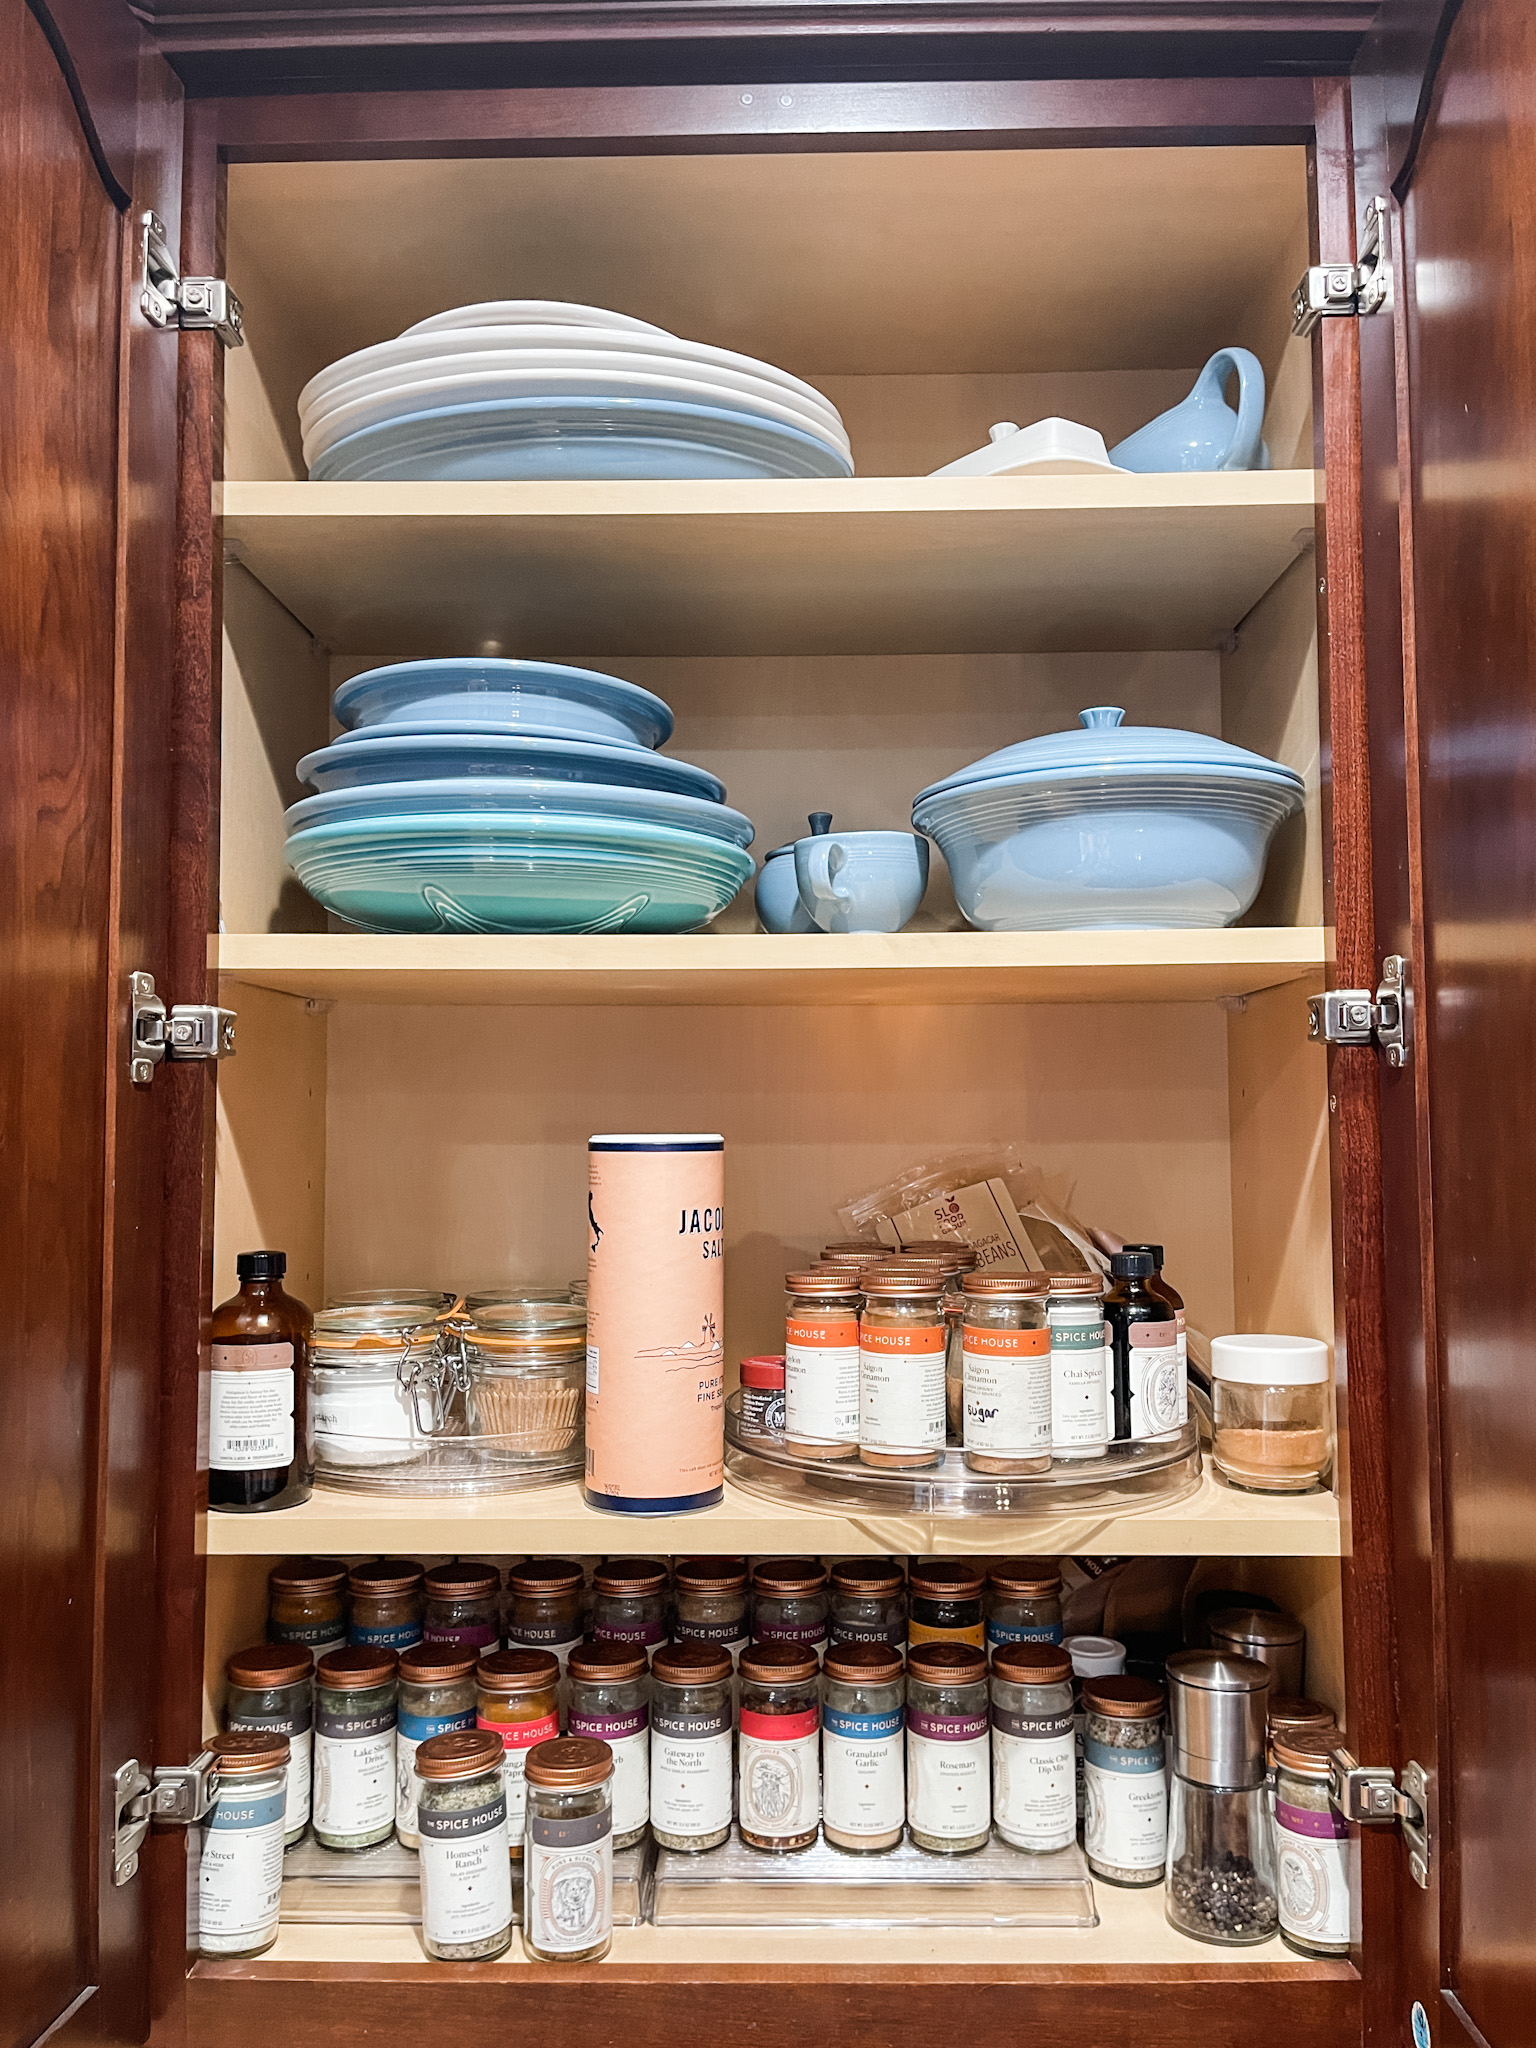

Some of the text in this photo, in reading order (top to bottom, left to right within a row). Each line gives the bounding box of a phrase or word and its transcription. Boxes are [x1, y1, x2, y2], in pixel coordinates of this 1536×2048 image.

[679, 1206, 723, 1234] JACO
[938, 1213, 964, 1229] OOD
[941, 1219, 967, 1235] GOUP
[976, 1241, 1016, 1268] BEANS
[794, 1329, 826, 1340] HOUSE
[875, 1335, 911, 1346] HOUSE
[1055, 1332, 1086, 1342] SPICE
[981, 1337, 1018, 1348] HOUSE
[863, 1362, 883, 1373] Saigon
[968, 1363, 990, 1374] Saigon
[1063, 1369, 1083, 1378] Chai
[698, 1377, 718, 1390] PURE
[964, 1372, 997, 1384] Cinnamon
[697, 1390, 715, 1403] FINE
[288, 1625, 345, 1641] SPICE HOU
[367, 1629, 421, 1644] SPICE HOUS
[524, 1630, 556, 1639] HOUSE
[613, 1631, 647, 1641] HOUSE
[681, 1626, 739, 1638] SPICE HOUSE
[770, 1630, 798, 1640] SPICE
[800, 1625, 826, 1639] HOUSE
[833, 1626, 888, 1642] SPICE HOUSE
[995, 1629, 1054, 1642] SPICE HOUSE
[255, 1721, 294, 1734] HOUSE
[346, 1718, 378, 1732] SPICE
[437, 1719, 467, 1734] SPICE
[575, 1717, 639, 1733] SPICE HOUSE
[659, 1717, 721, 1731] SPICE HOUSE
[839, 1719, 868, 1732] SPICE
[871, 1716, 900, 1731] HOUSE
[930, 1722, 960, 1734] SPICE
[963, 1718, 988, 1733] HOUSE
[1021, 1721, 1052, 1732] SPICE
[501, 1722, 554, 1741] ICE HOUSE
[353, 1748, 372, 1758] Lake
[664, 1747, 705, 1758] Gateway to
[845, 1748, 888, 1759] Granulated
[364, 1753, 384, 1765] Drive
[666, 1757, 702, 1767] the North
[855, 1759, 879, 1767] Garlic
[940, 1760, 976, 1770] Rosemary
[1029, 1756, 1055, 1765] Classic
[1038, 1766, 1052, 1775] Dip
[215, 1809, 255, 1821] HOUSE
[436, 1818, 469, 1831] SPICE
[472, 1804, 504, 1827] HOUSE
[210, 1850, 235, 1860] Street
[446, 1844, 490, 1860] Homestyle
[455, 1856, 482, 1868] Ranch
